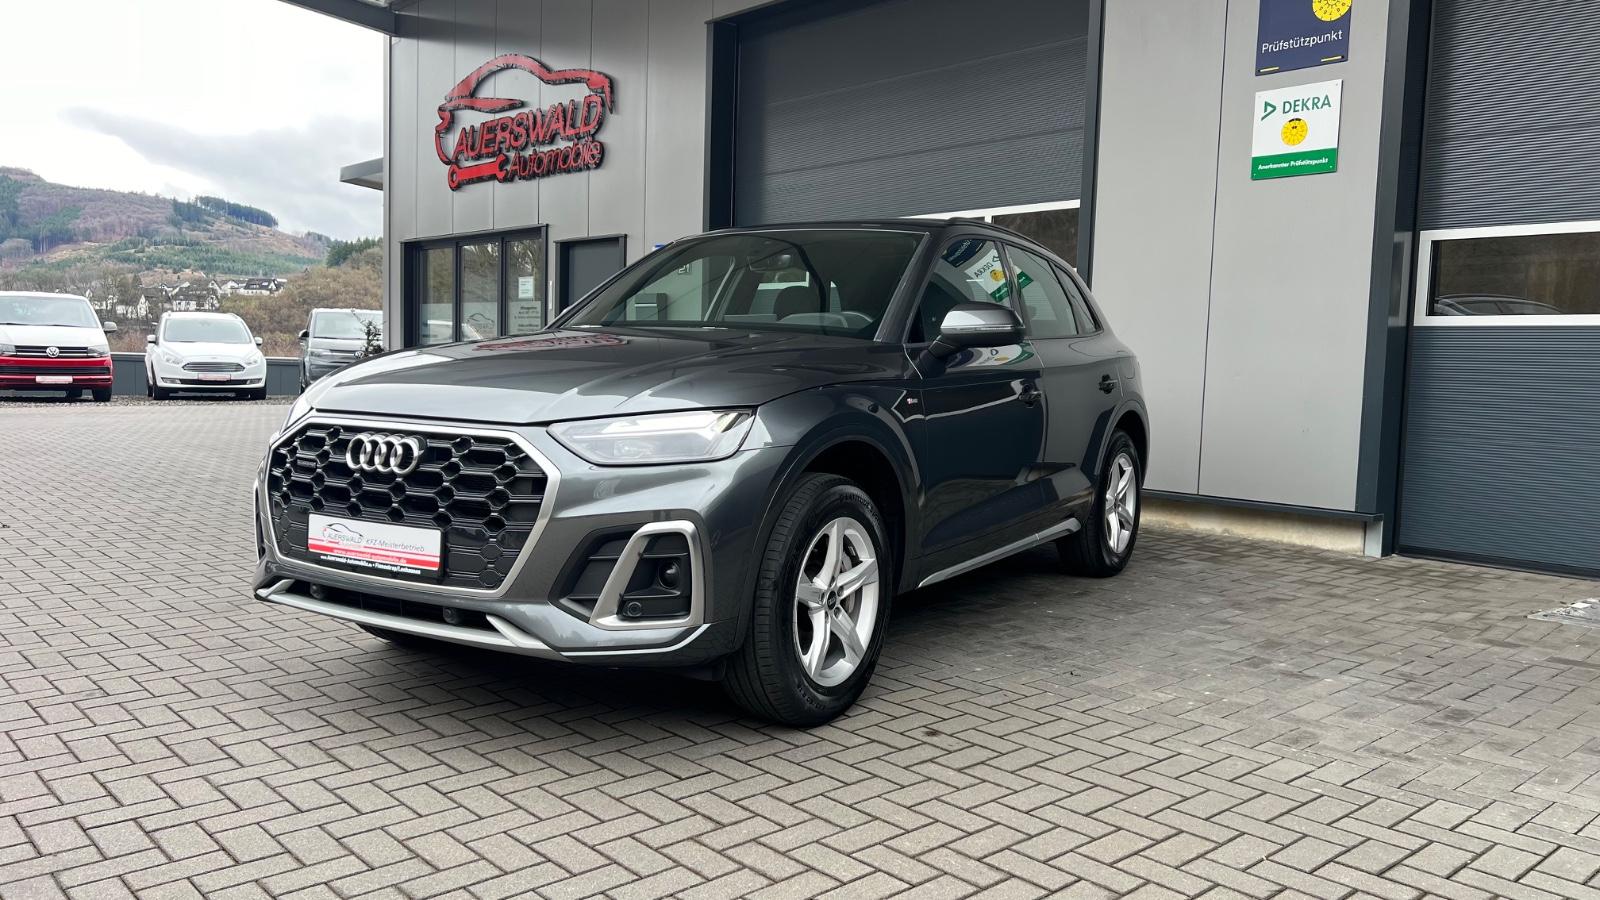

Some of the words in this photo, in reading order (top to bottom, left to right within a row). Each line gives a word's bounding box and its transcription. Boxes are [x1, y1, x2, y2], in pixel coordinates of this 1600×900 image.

[1262, 30, 1343, 53] Prüfstützpunkt
[1282, 94, 1332, 114] DEKRA
[451, 93, 603, 162] AUERSWALD
[508, 138, 602, 178] Automobile
